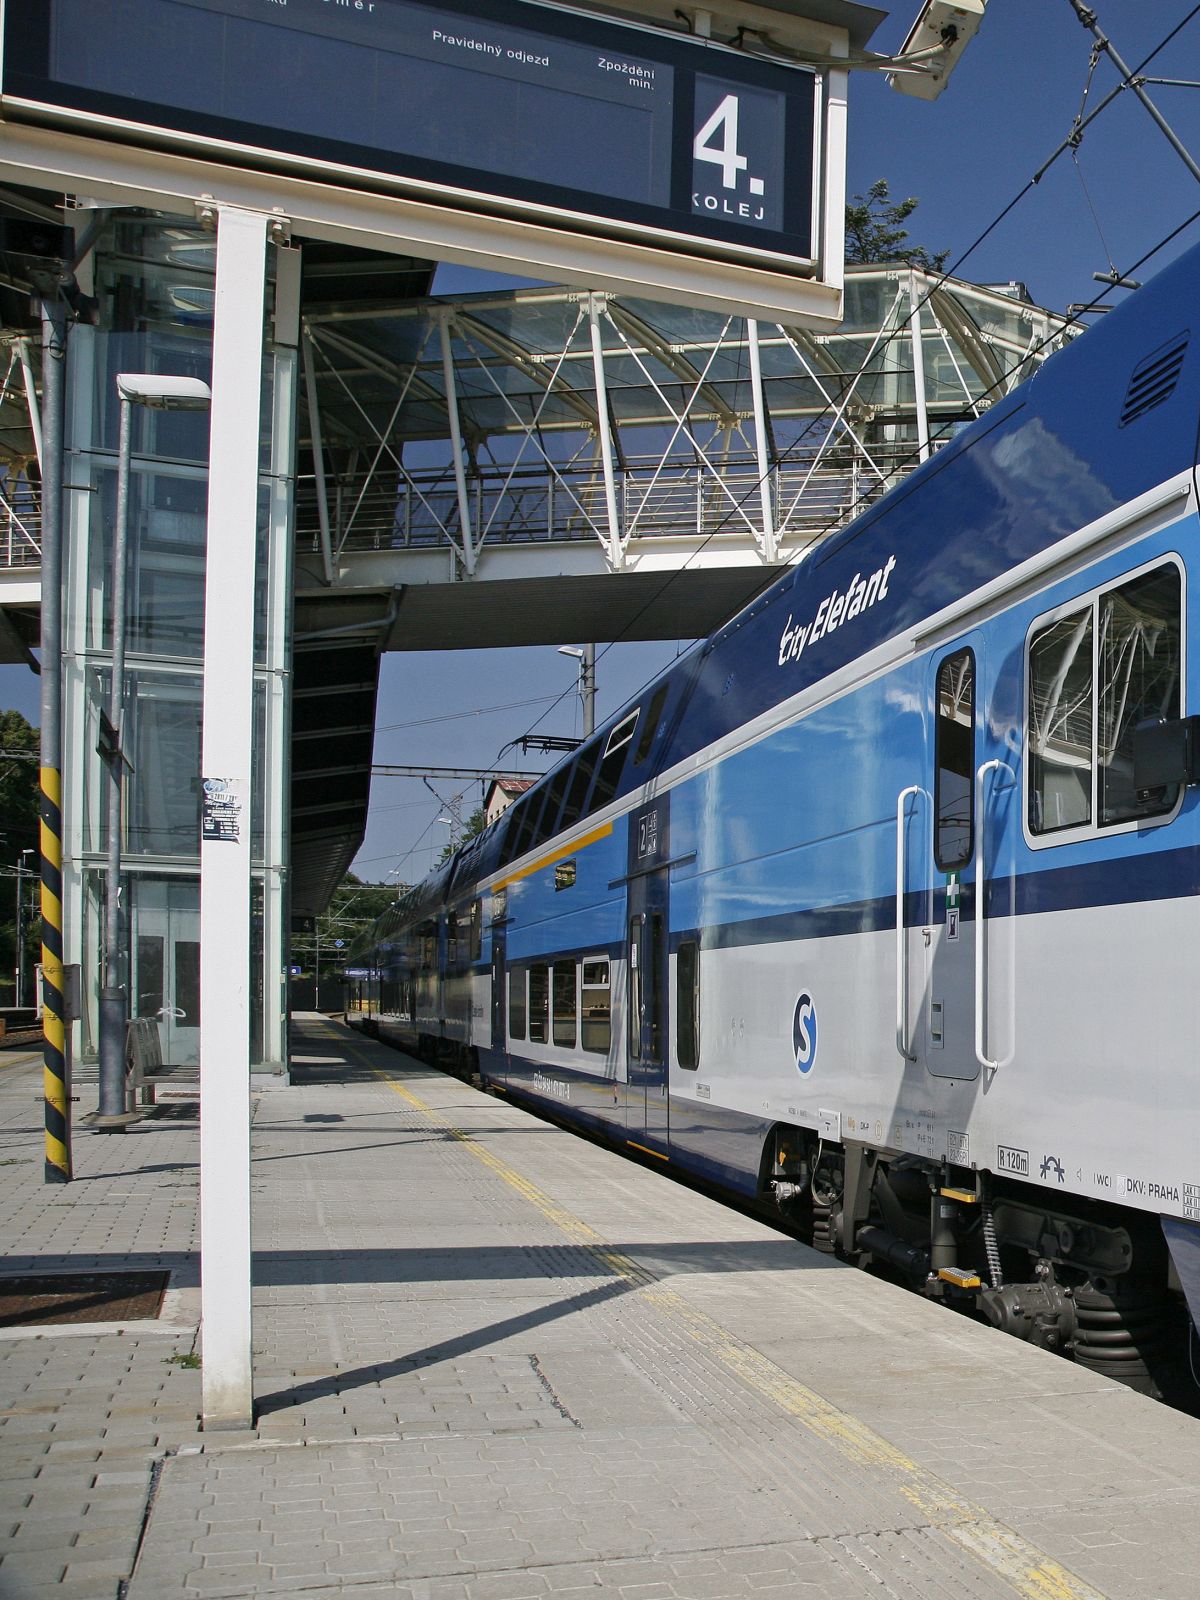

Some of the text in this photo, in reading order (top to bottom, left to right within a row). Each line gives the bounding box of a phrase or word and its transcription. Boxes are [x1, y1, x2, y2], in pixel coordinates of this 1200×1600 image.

[432, 30, 550, 67] Pravidelný odjezd
[598, 57, 655, 80] Zpoždění
[629, 77, 655, 90] min.
[693, 94, 765, 196] 4.
[778, 554, 897, 666] City Elefant
[1000, 1150, 1027, 1172] R 120m
[1127, 1178, 1146, 1195] DKV:
[1148, 1183, 1180, 1202] PRAHA
